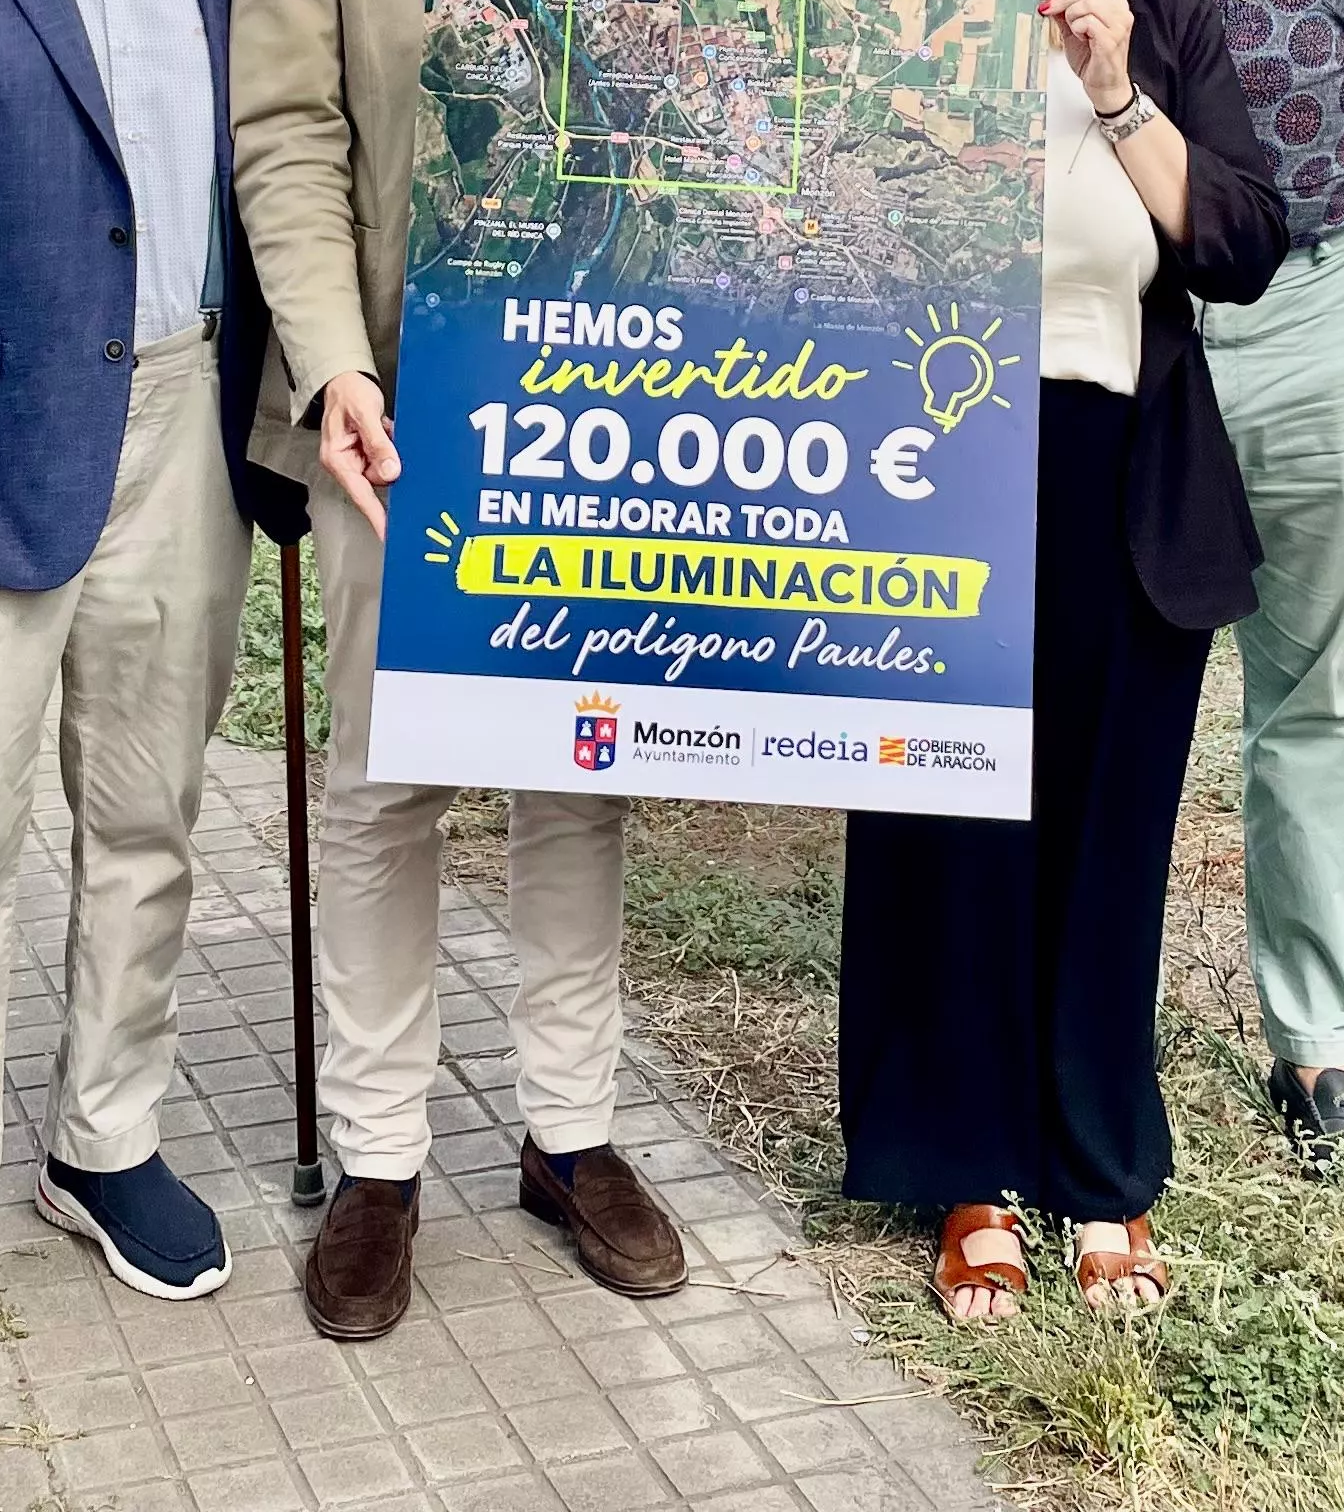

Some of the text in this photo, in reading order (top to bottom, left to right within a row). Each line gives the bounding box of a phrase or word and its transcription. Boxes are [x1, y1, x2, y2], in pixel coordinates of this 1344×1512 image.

[504, 298, 684, 349] HEMOS
[520, 338, 870, 401] invertido
[468, 402, 937, 501] 120.000 €
[478, 489, 850, 544] EN MEJORAR TODA
[492, 543, 960, 610] LA ILUMINACIÓN
[490, 601, 947, 682] del polígono Paules.
[632, 746, 741, 768] Ayuntamiento
[633, 720, 742, 750] Monzón
[761, 731, 868, 764] redeia
[906, 738, 986, 756] GOBIERNO
[906, 753, 929, 768] DE
